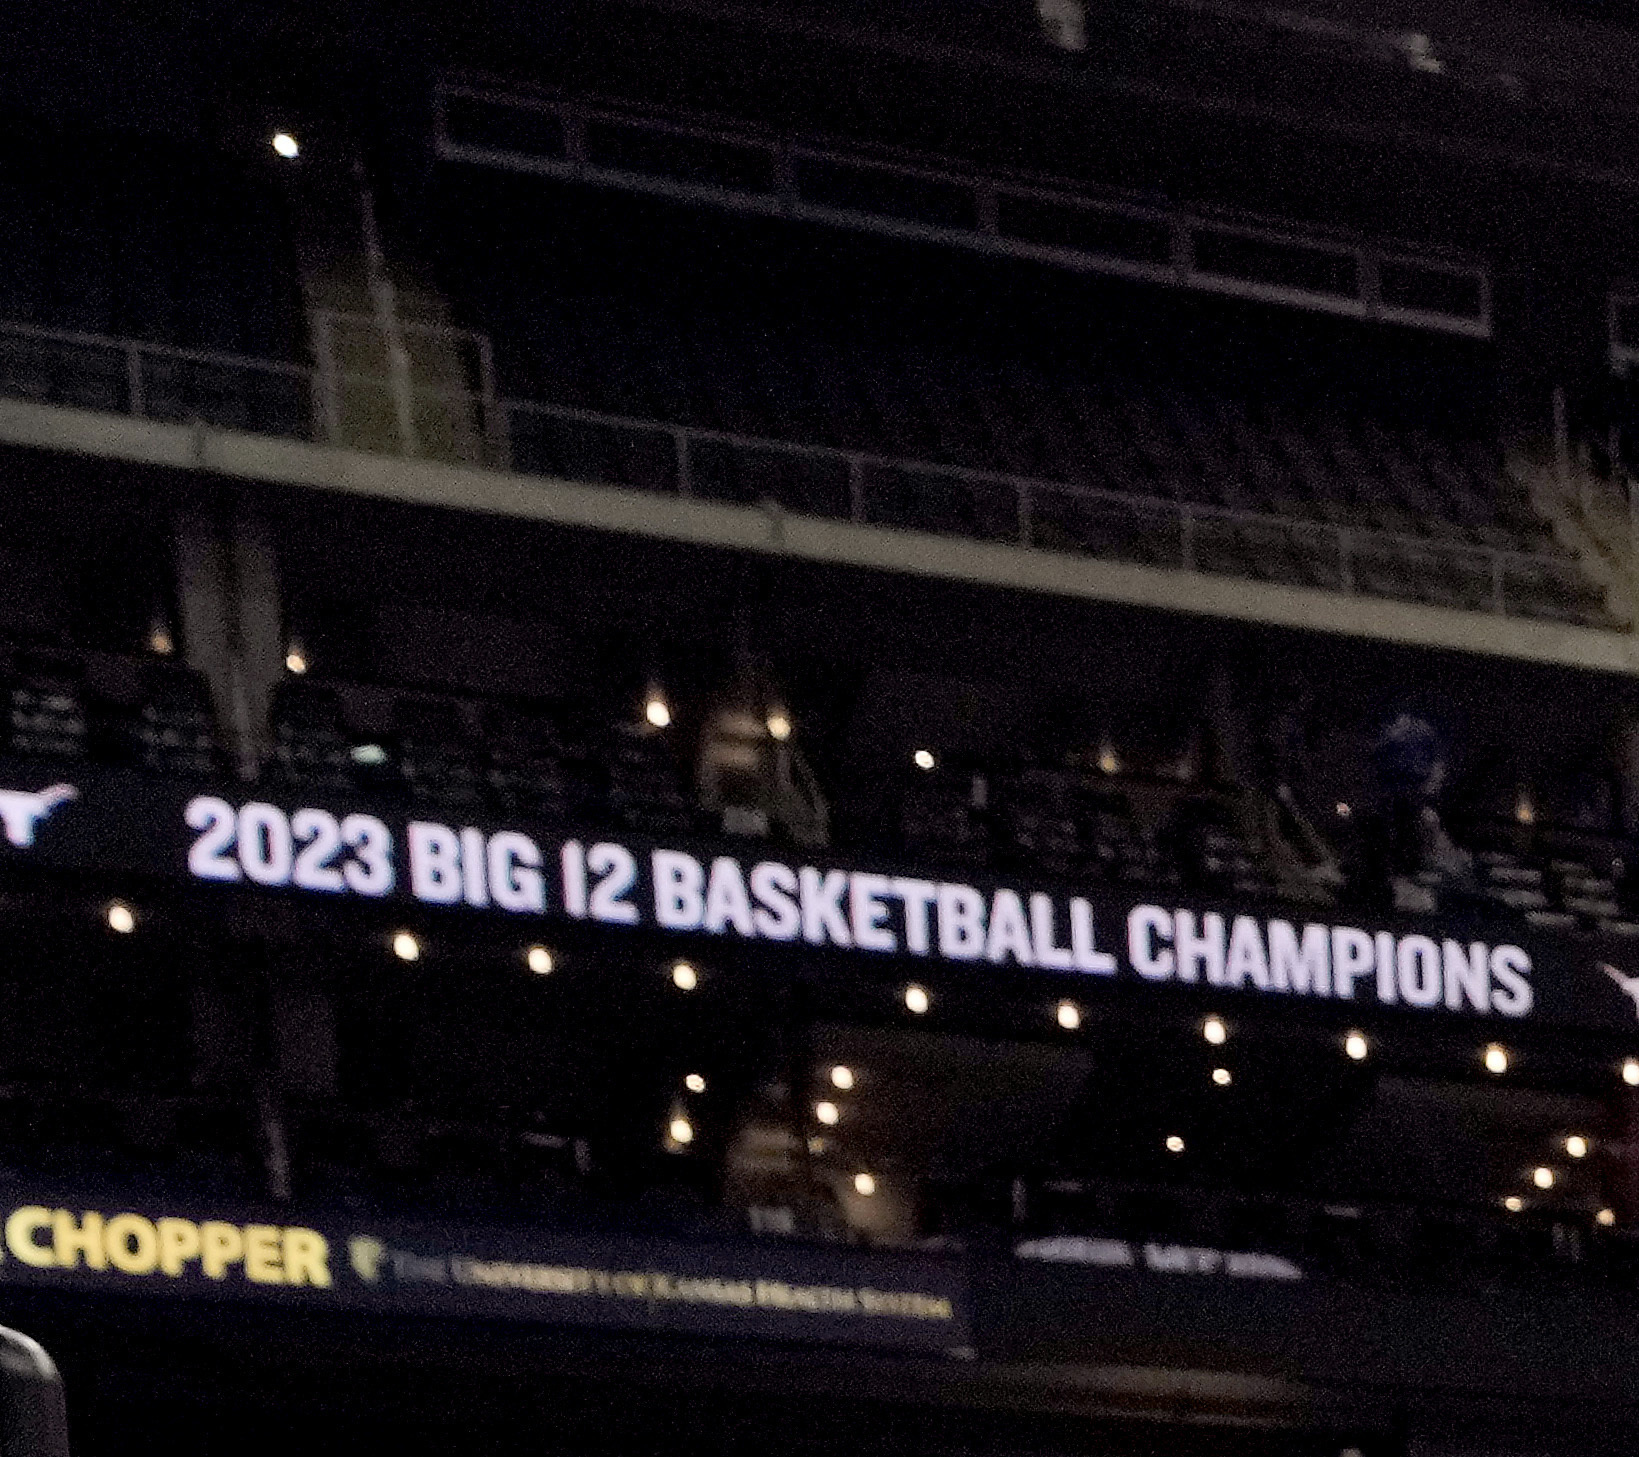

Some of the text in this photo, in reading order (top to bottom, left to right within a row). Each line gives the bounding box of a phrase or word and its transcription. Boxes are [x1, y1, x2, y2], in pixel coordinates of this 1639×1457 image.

[186, 796, 1534, 1016] 2023 BIG 12 BASKETBALL CHAMPIONS
[5, 1205, 332, 1288] CHOPPER
